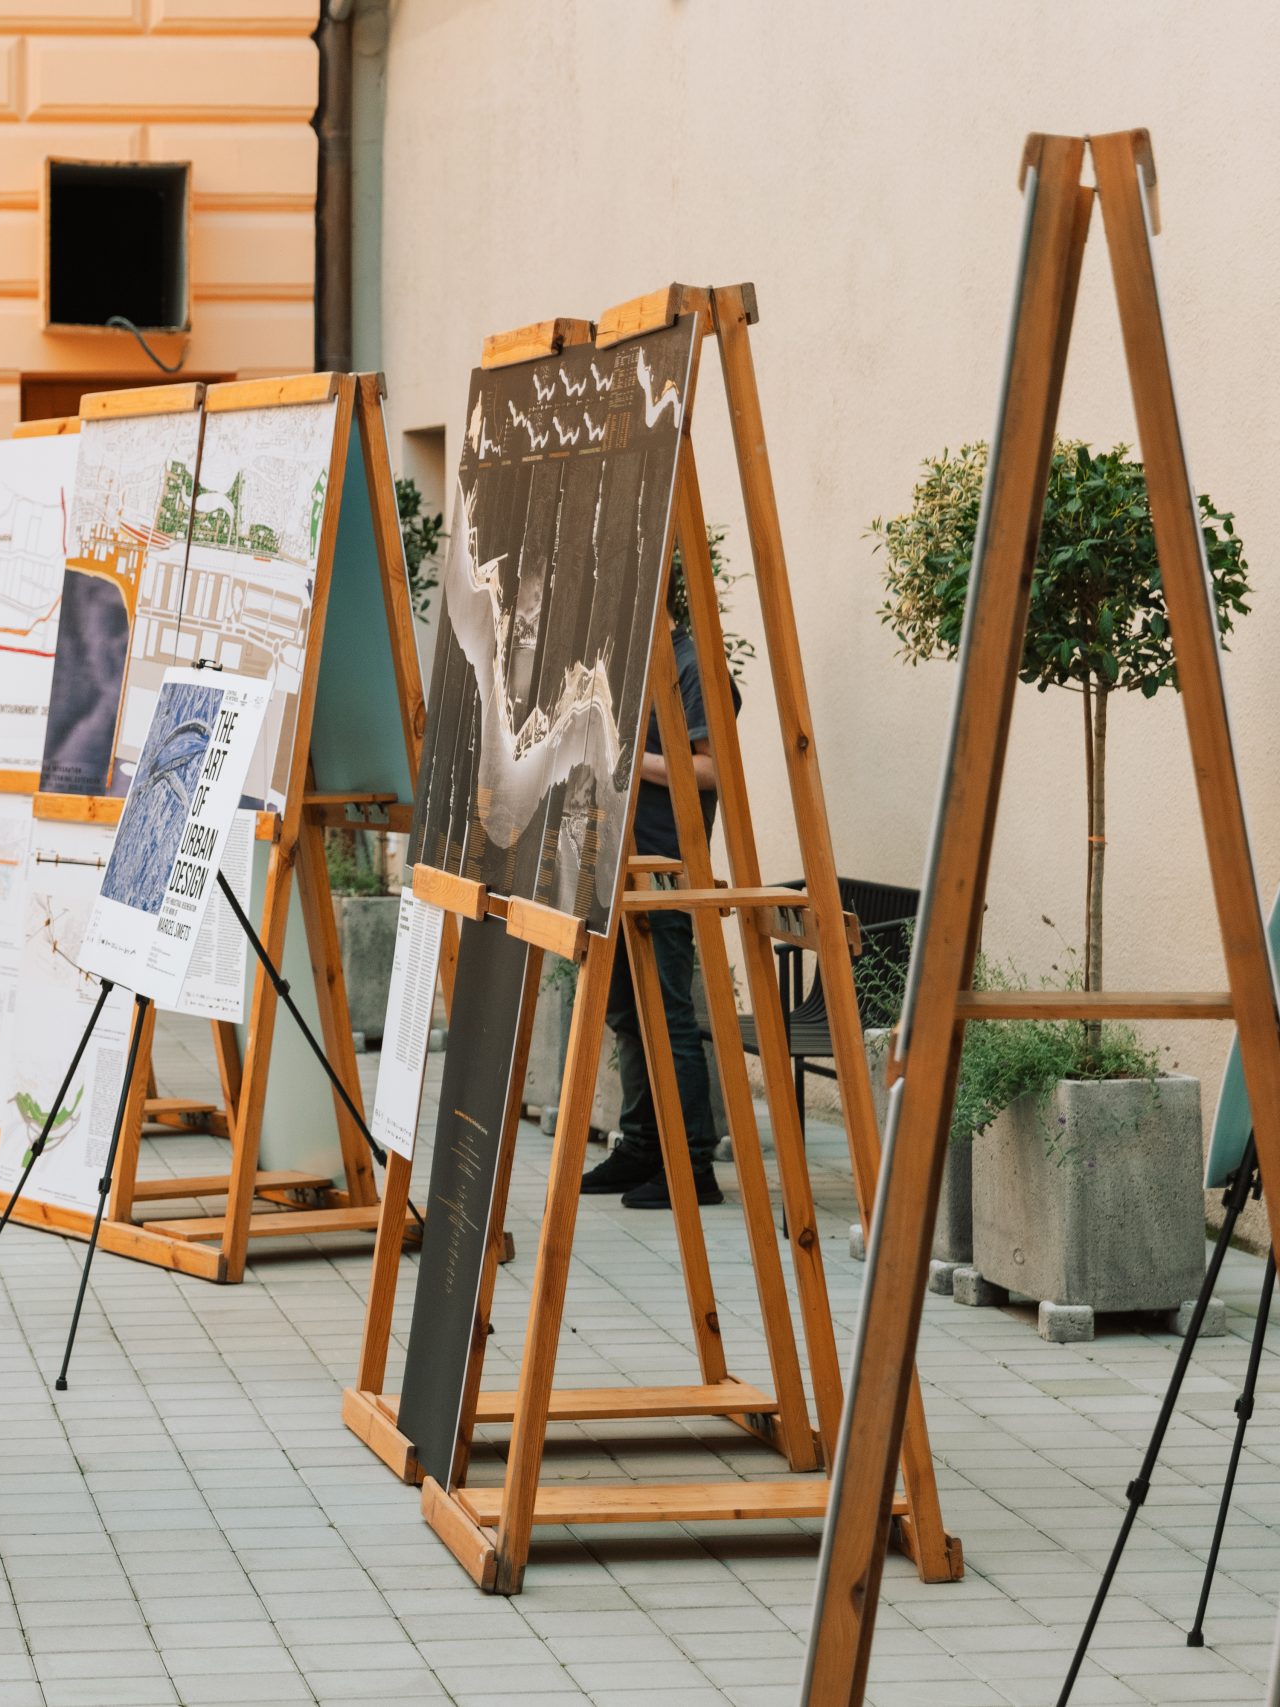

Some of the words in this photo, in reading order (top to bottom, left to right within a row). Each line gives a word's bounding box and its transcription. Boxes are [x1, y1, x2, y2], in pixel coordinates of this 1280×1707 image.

[214, 710, 239, 744] THE
[202, 748, 228, 781] ART
[191, 785, 210, 817] OF
[181, 822, 219, 861] URBAN
[169, 860, 209, 900] DESIGN
